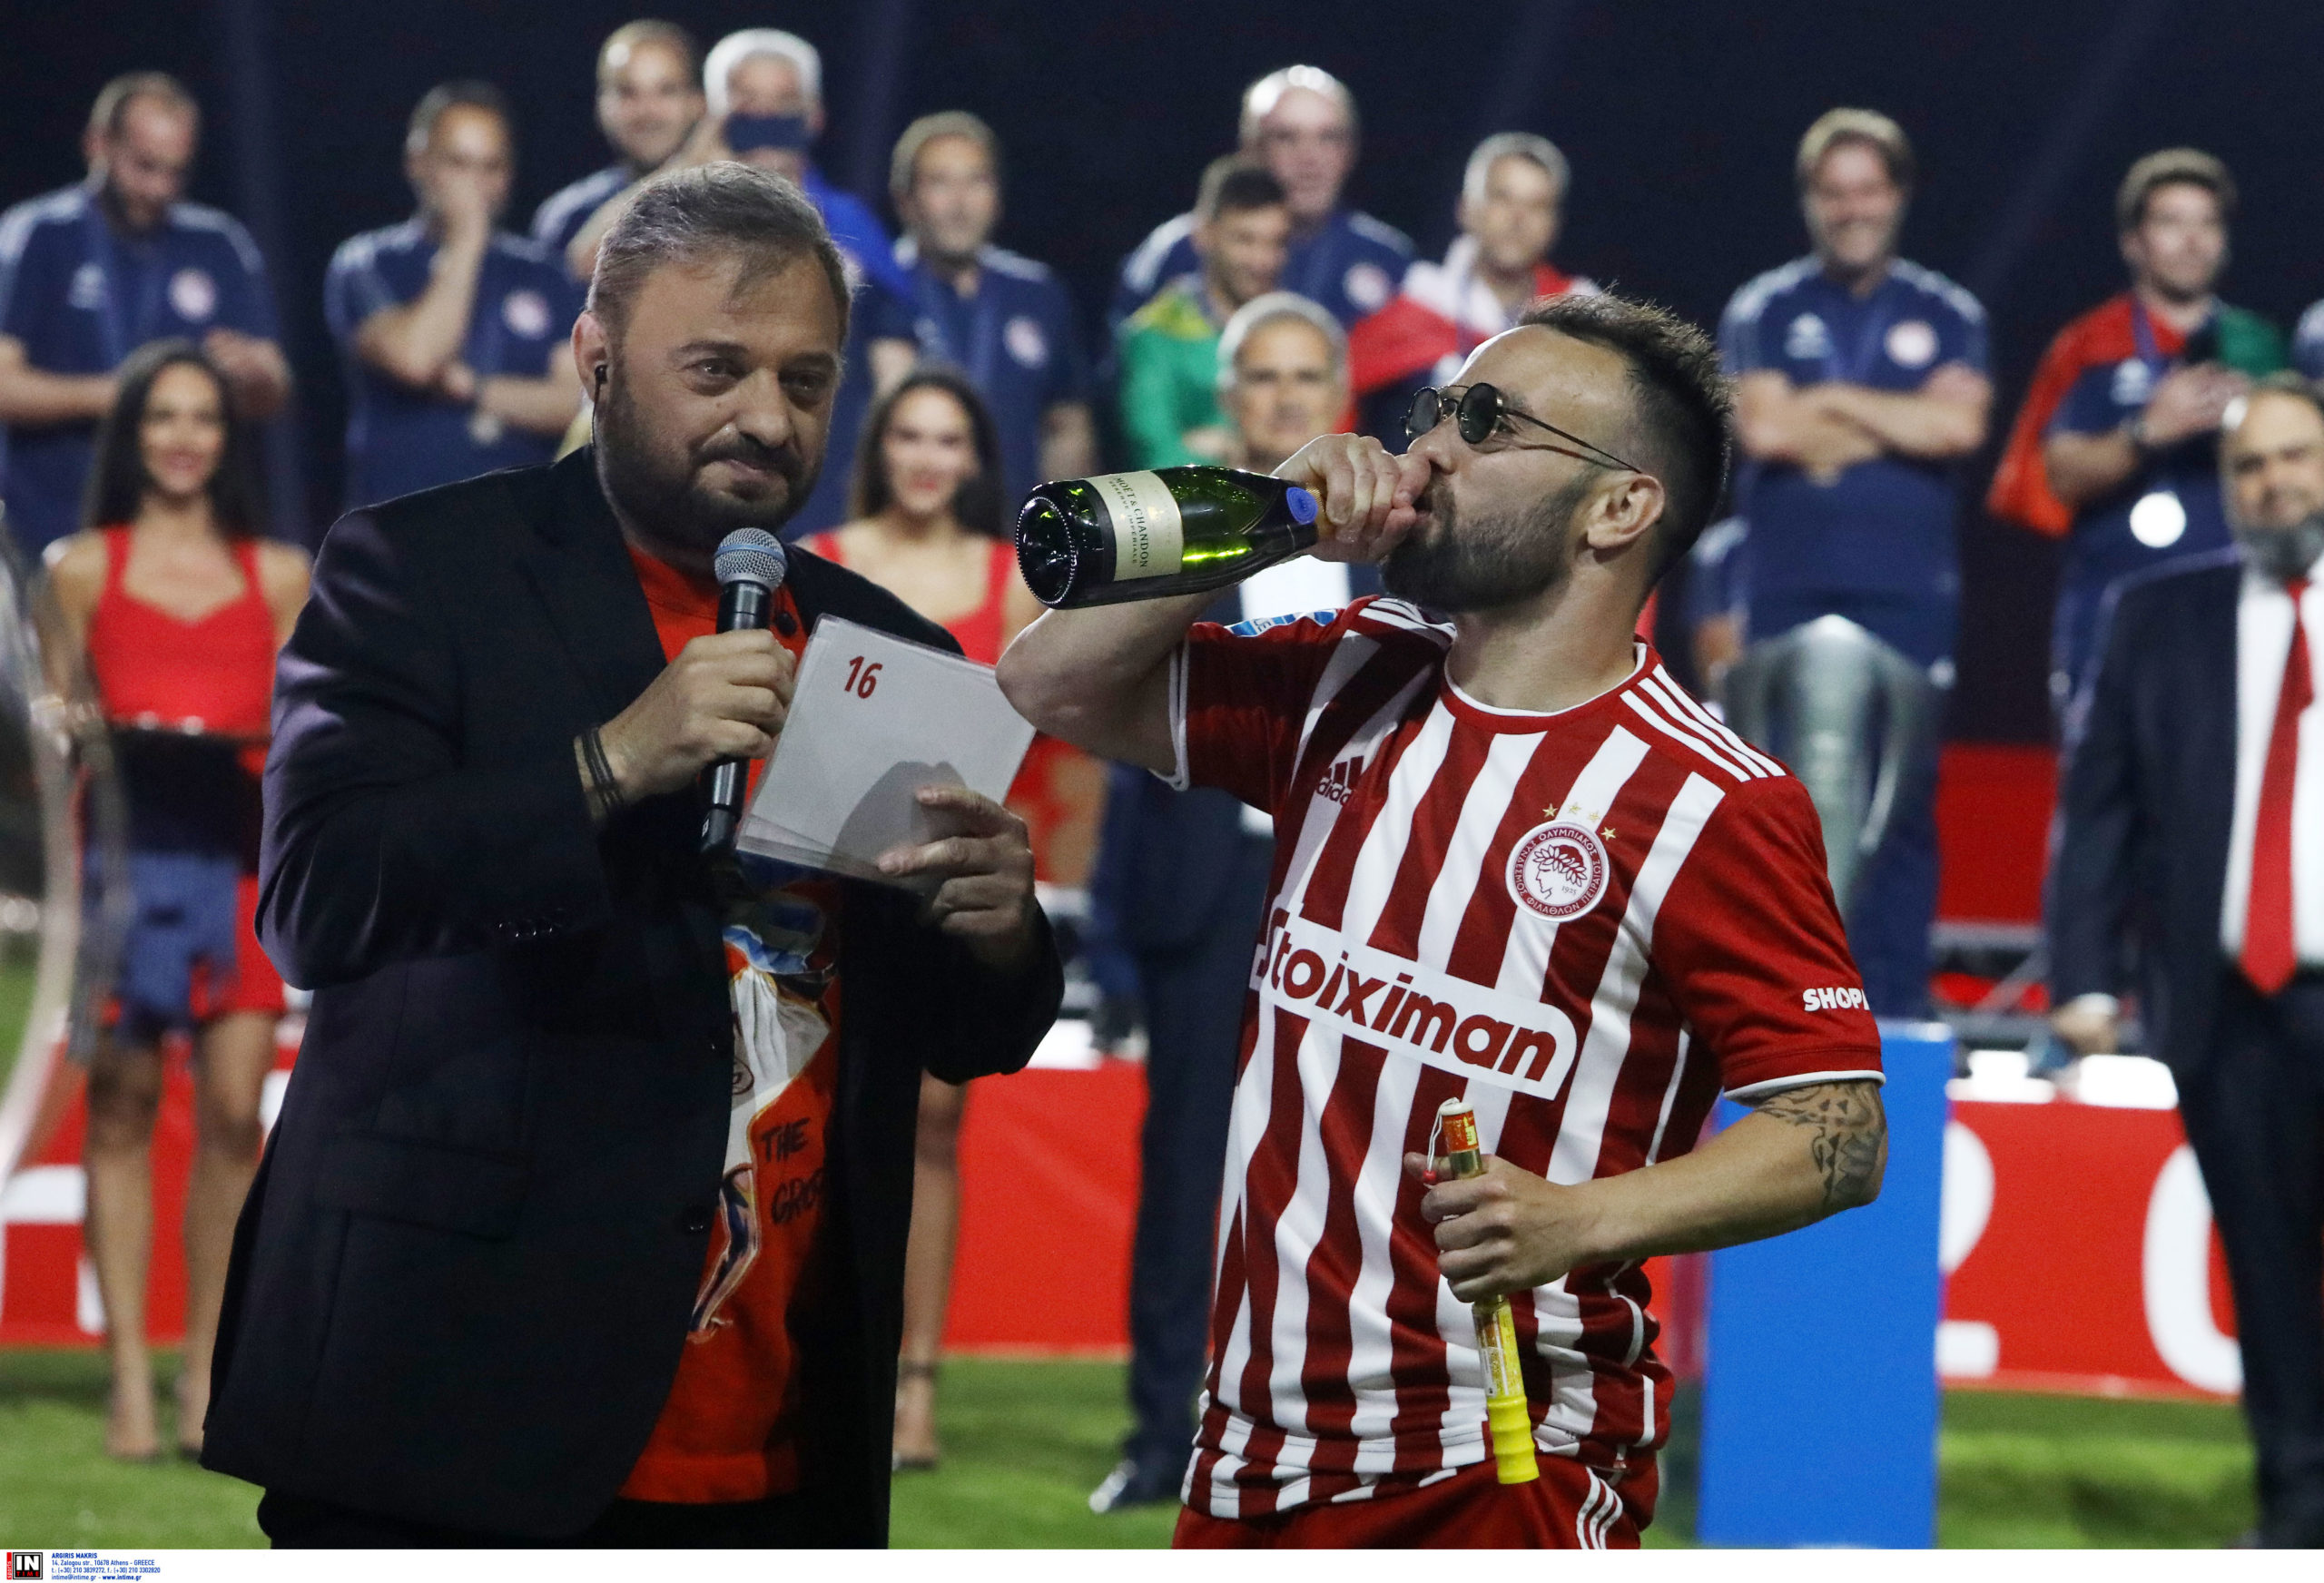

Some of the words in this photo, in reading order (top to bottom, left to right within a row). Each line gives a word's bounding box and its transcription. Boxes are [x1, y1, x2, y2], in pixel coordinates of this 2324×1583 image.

[1134, 508, 1149, 568] CHANDON
[844, 654, 883, 699] 16
[1539, 827, 1598, 856] ΟΛΥΜΠΙΑΚΟΣ
[1515, 841, 1537, 897] ΣΥΝΔΕΣΜΟΣ
[1561, 885, 1577, 896] 1925
[1583, 860, 1602, 904] ΠΕΙΡΑΙΩΣ
[1526, 897, 1581, 915] ΦΙΛΑΘΛΩΝ
[761, 1117, 812, 1163] THE
